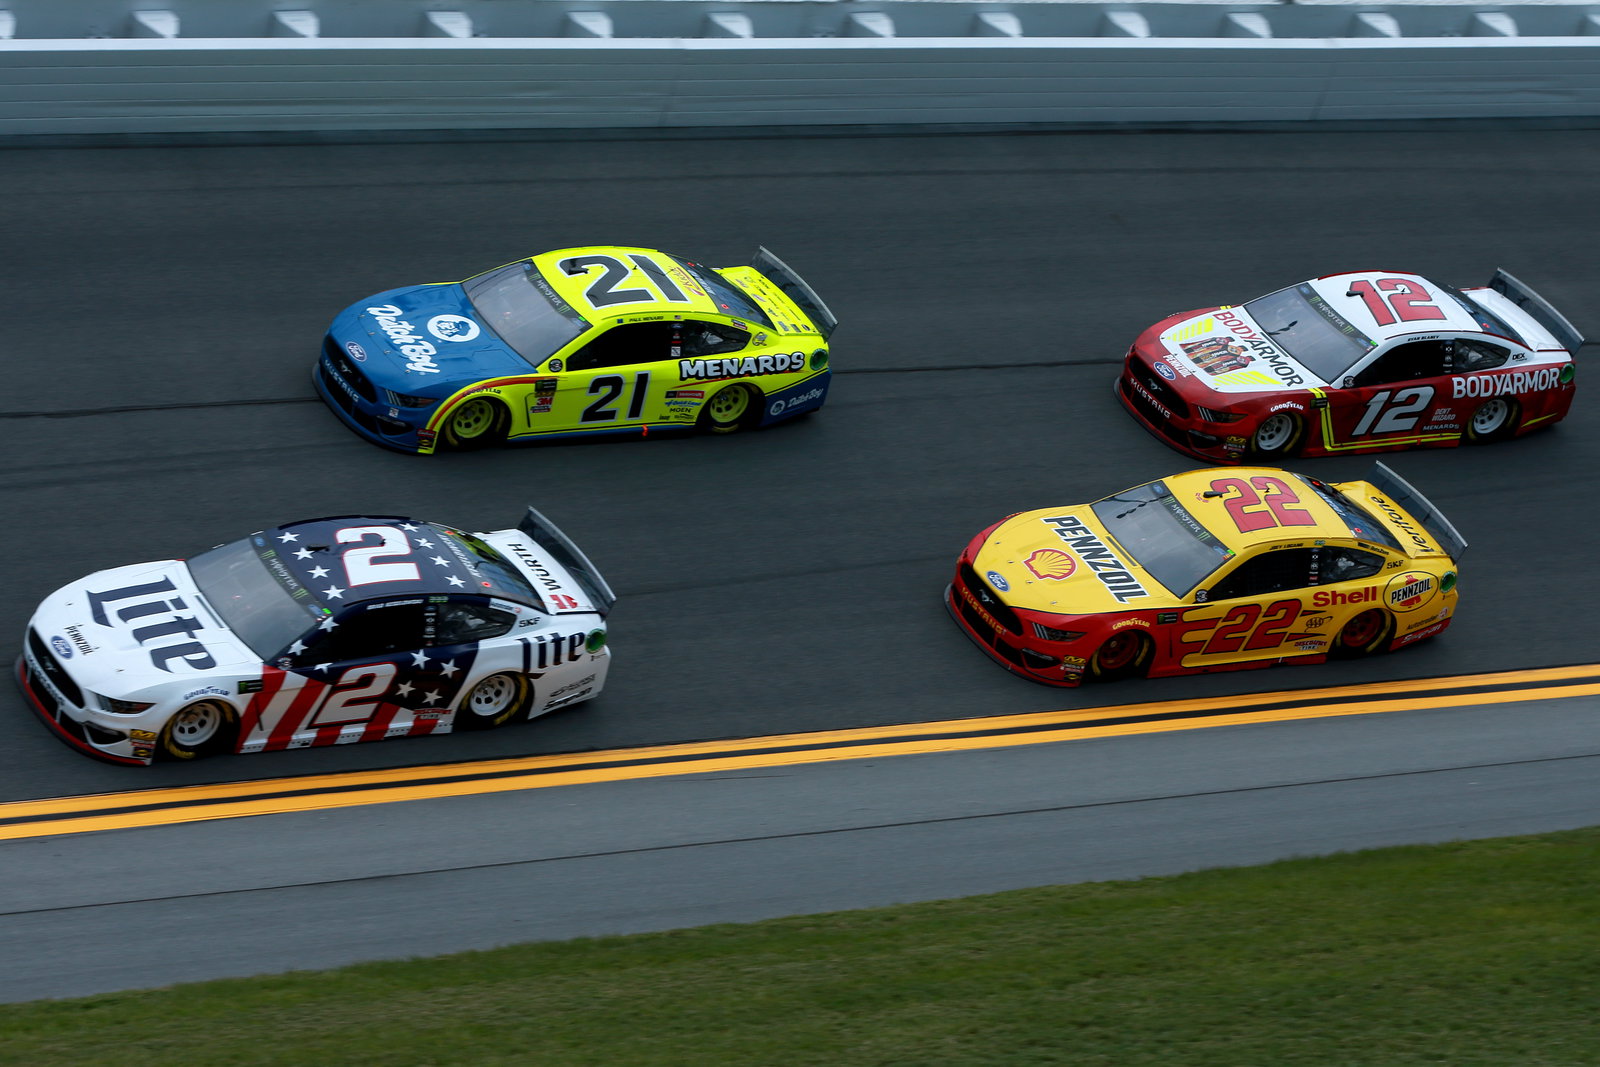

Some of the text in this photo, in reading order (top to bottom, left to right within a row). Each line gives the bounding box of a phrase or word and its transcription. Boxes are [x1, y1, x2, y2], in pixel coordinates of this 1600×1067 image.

[557, 253, 692, 310] 21
[1349, 278, 1447, 328] 12
[366, 303, 440, 374] Dutch Boy
[1213, 311, 1304, 387] BODYARMOR
[679, 352, 805, 380] MENARDS
[1452, 367, 1560, 398] BODYARMOR
[579, 370, 651, 425] 21
[1130, 378, 1171, 419] MUSTANG
[1270, 401, 1304, 412] GOODYEAR
[1352, 385, 1435, 436] 12
[1210, 476, 1317, 533] 22
[1370, 496, 1435, 552] Verifone
[335, 525, 421, 587] 2
[1040, 515, 1150, 604] PENNZOIL
[1387, 560, 1404, 569] SKF
[988, 573, 1008, 590] Ford
[1313, 586, 1377, 607] Shell
[1391, 578, 1433, 604] PENNZOIL
[86, 575, 217, 673] Lite
[519, 617, 540, 627] SKF
[962, 587, 1003, 634] MUSTANG
[1112, 618, 1150, 630] GOODYEAR
[1200, 599, 1302, 655] 22
[307, 662, 397, 729] 2
